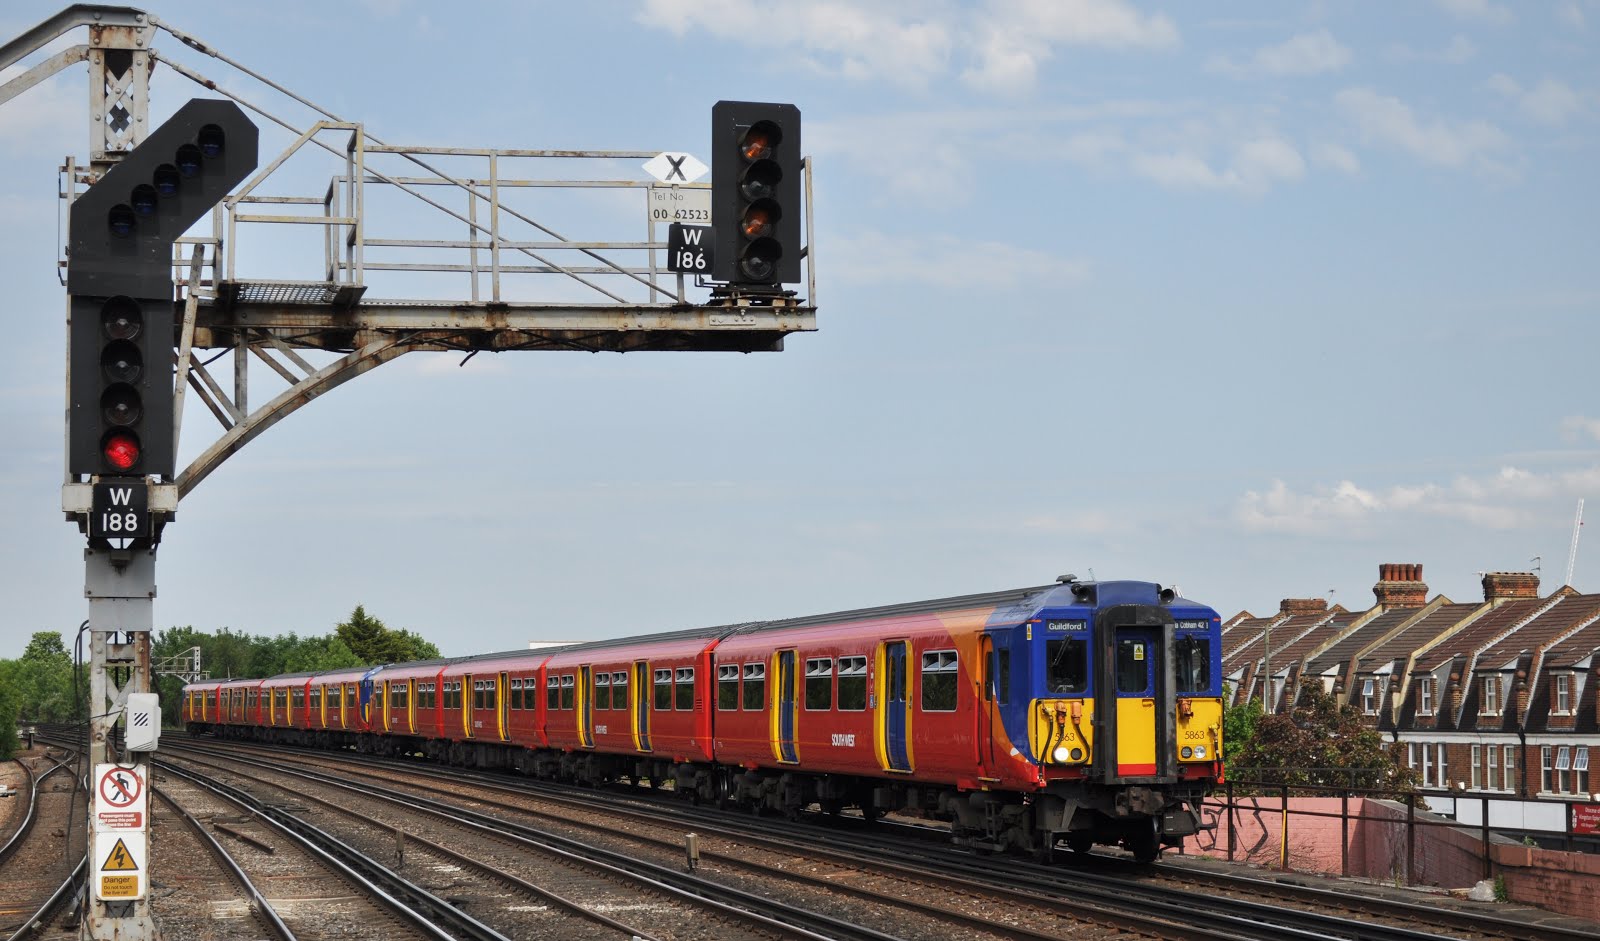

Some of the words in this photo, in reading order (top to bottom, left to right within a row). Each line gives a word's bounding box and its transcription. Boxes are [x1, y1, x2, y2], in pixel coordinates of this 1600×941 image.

[665, 155, 687, 181] X
[653, 192, 666, 200] Tel
[653, 209, 668, 219] 00
[675, 209, 709, 220] 62523
[682, 228, 703, 246] W
[676, 251, 706, 270] 186
[109, 488, 132, 506] W
[103, 513, 137, 532] 188
[1048, 622, 1082, 630] Guildford
[1055, 732, 1075, 742] 563
[1185, 730, 1205, 740] 5863
